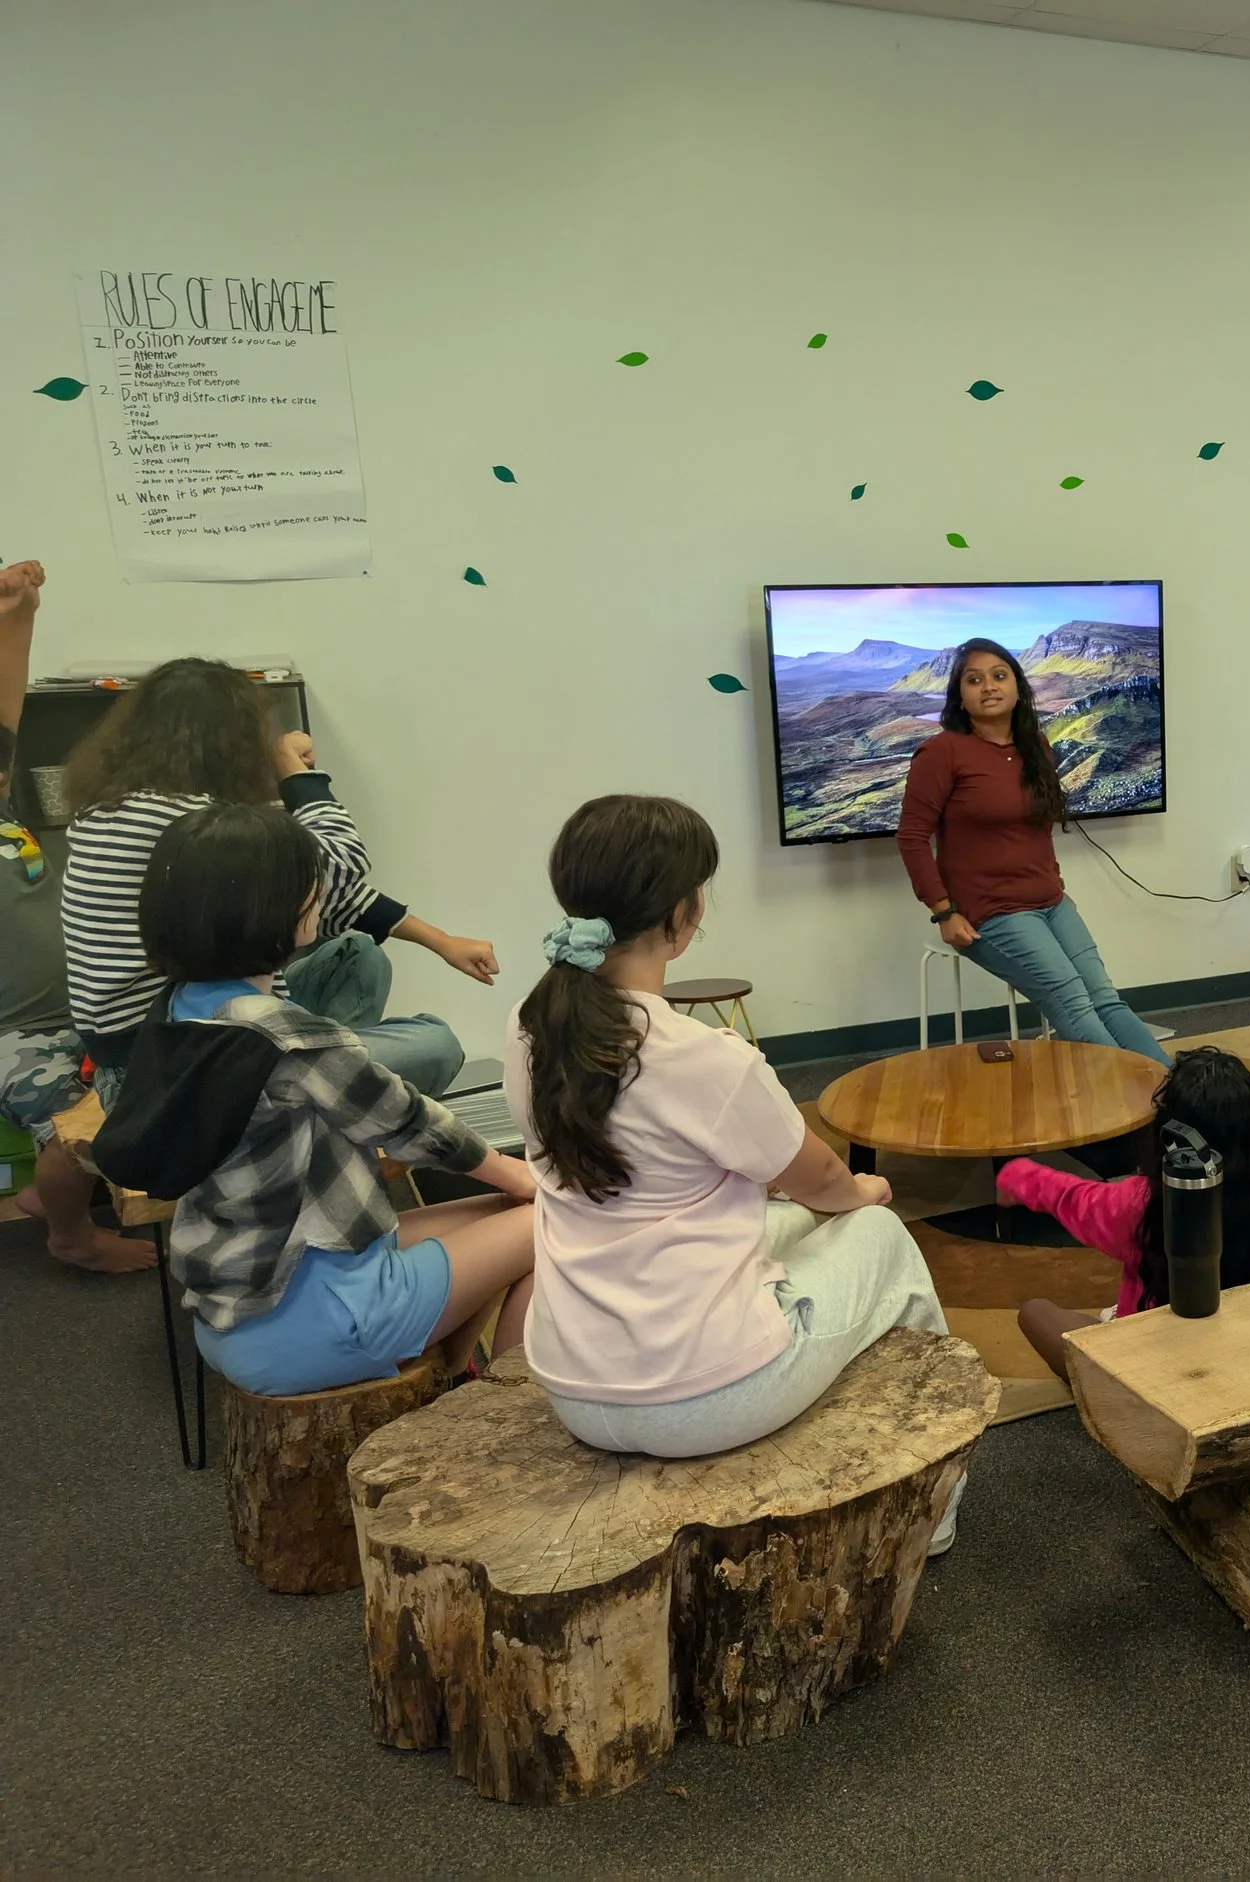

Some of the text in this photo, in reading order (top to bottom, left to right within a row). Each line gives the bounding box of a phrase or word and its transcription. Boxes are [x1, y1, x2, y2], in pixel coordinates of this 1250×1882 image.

[101, 269, 177, 330] RULES
[187, 277, 214, 330] OF
[153, 391, 180, 403] bring
[270, 396, 288, 404] the
[184, 441, 192, 451] is
[190, 488, 198, 497] is
